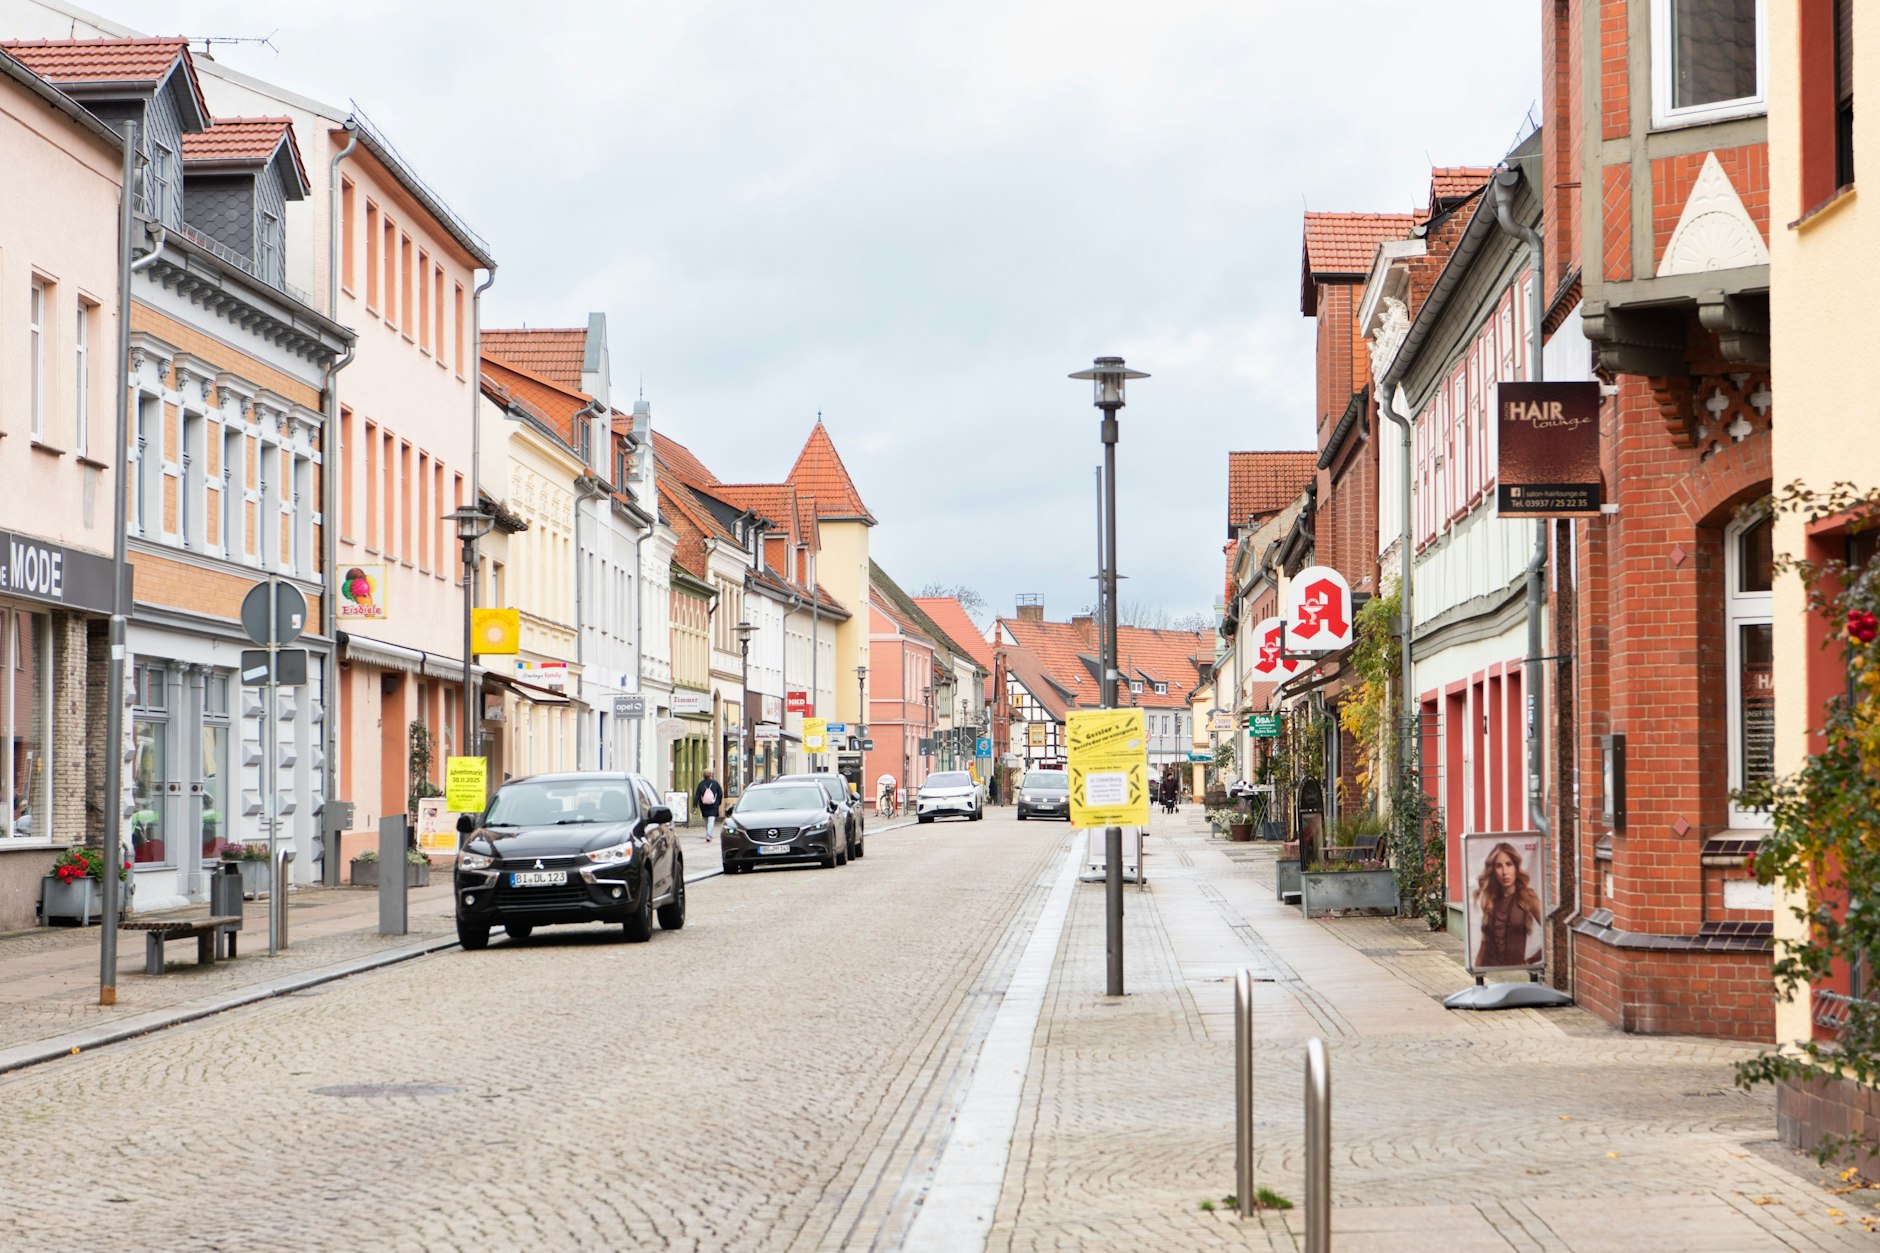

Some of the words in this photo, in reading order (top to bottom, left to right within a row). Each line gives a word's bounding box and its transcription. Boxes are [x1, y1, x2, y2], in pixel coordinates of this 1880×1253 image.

[1509, 400, 1565, 421] HAIR
[1532, 417, 1592, 431] lounge
[1526, 490, 1588, 499] salon-hairlounge.de
[1555, 499, 1566, 507] 25
[1566, 499, 1577, 507] 22
[10, 541, 62, 597] MODE
[788, 698, 806, 706] NKD
[616, 702, 634, 713] apel
[548, 872, 565, 882] 123
